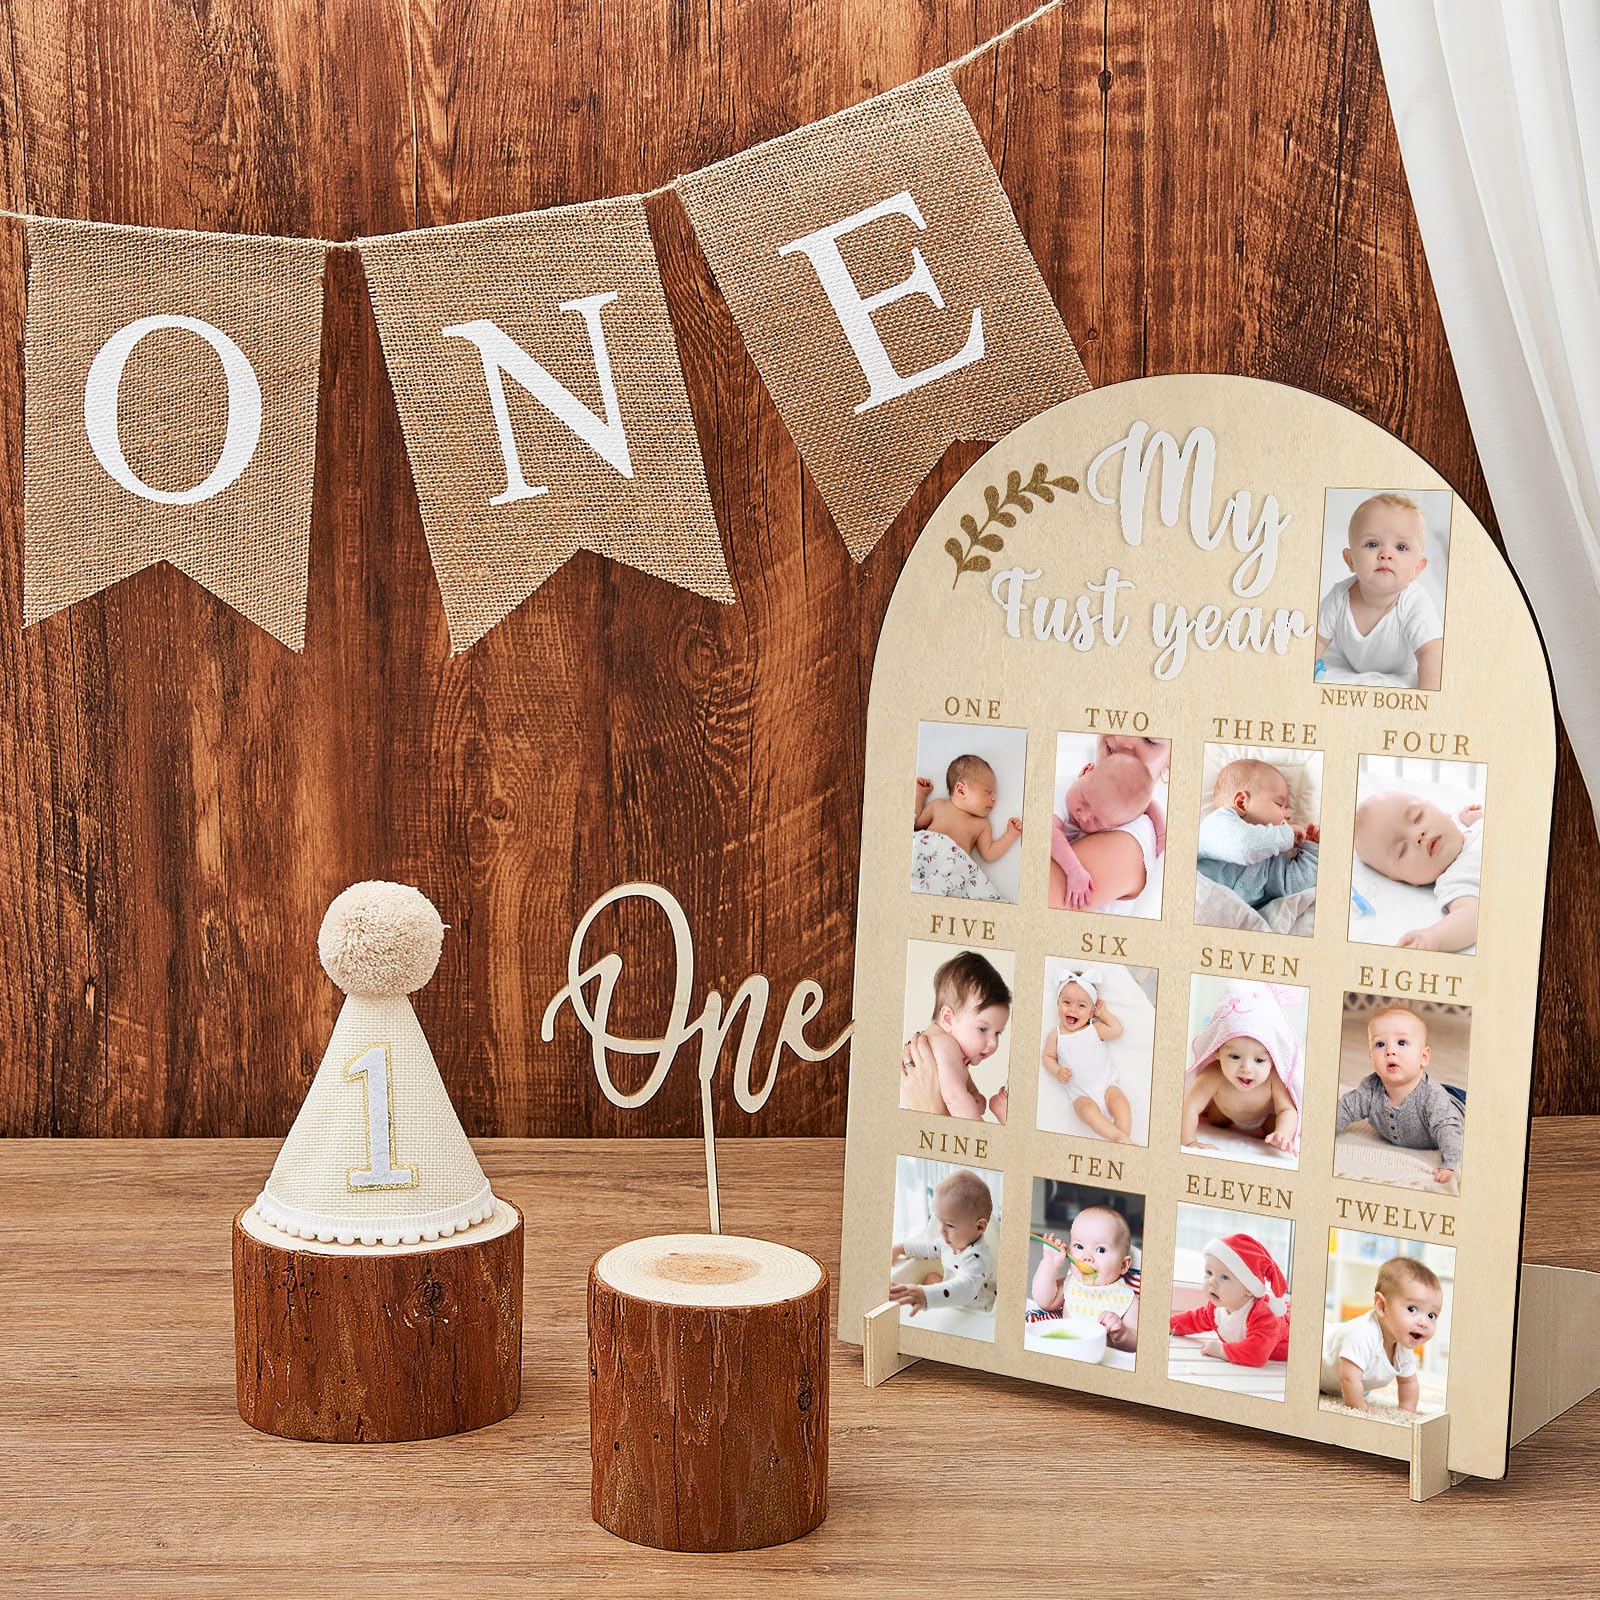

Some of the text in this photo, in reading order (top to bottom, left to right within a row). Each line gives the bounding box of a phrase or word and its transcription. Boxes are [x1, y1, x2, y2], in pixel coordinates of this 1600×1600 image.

[1087, 420, 1292, 599] My
[1152, 601, 1314, 681] year
[944, 696, 1001, 719] ONE
[1320, 688, 1430, 711] NEW BORN
[1085, 707, 1150, 732] TWO
[1212, 717, 1317, 744] THREE
[1382, 729, 1470, 756] FOUR
[930, 914, 995, 941] FIVE
[1080, 932, 1128, 957] SIX
[1200, 947, 1300, 977] SEVEN
[1358, 965, 1463, 997] EIGHT
[541, 881, 856, 1114] One
[343, 1042, 419, 1192] 1
[918, 1129, 988, 1158] NINE
[1068, 1153, 1125, 1181] TEN
[1185, 1173, 1294, 1210] ELEVEN
[1335, 1197, 1456, 1238] TWELVE
